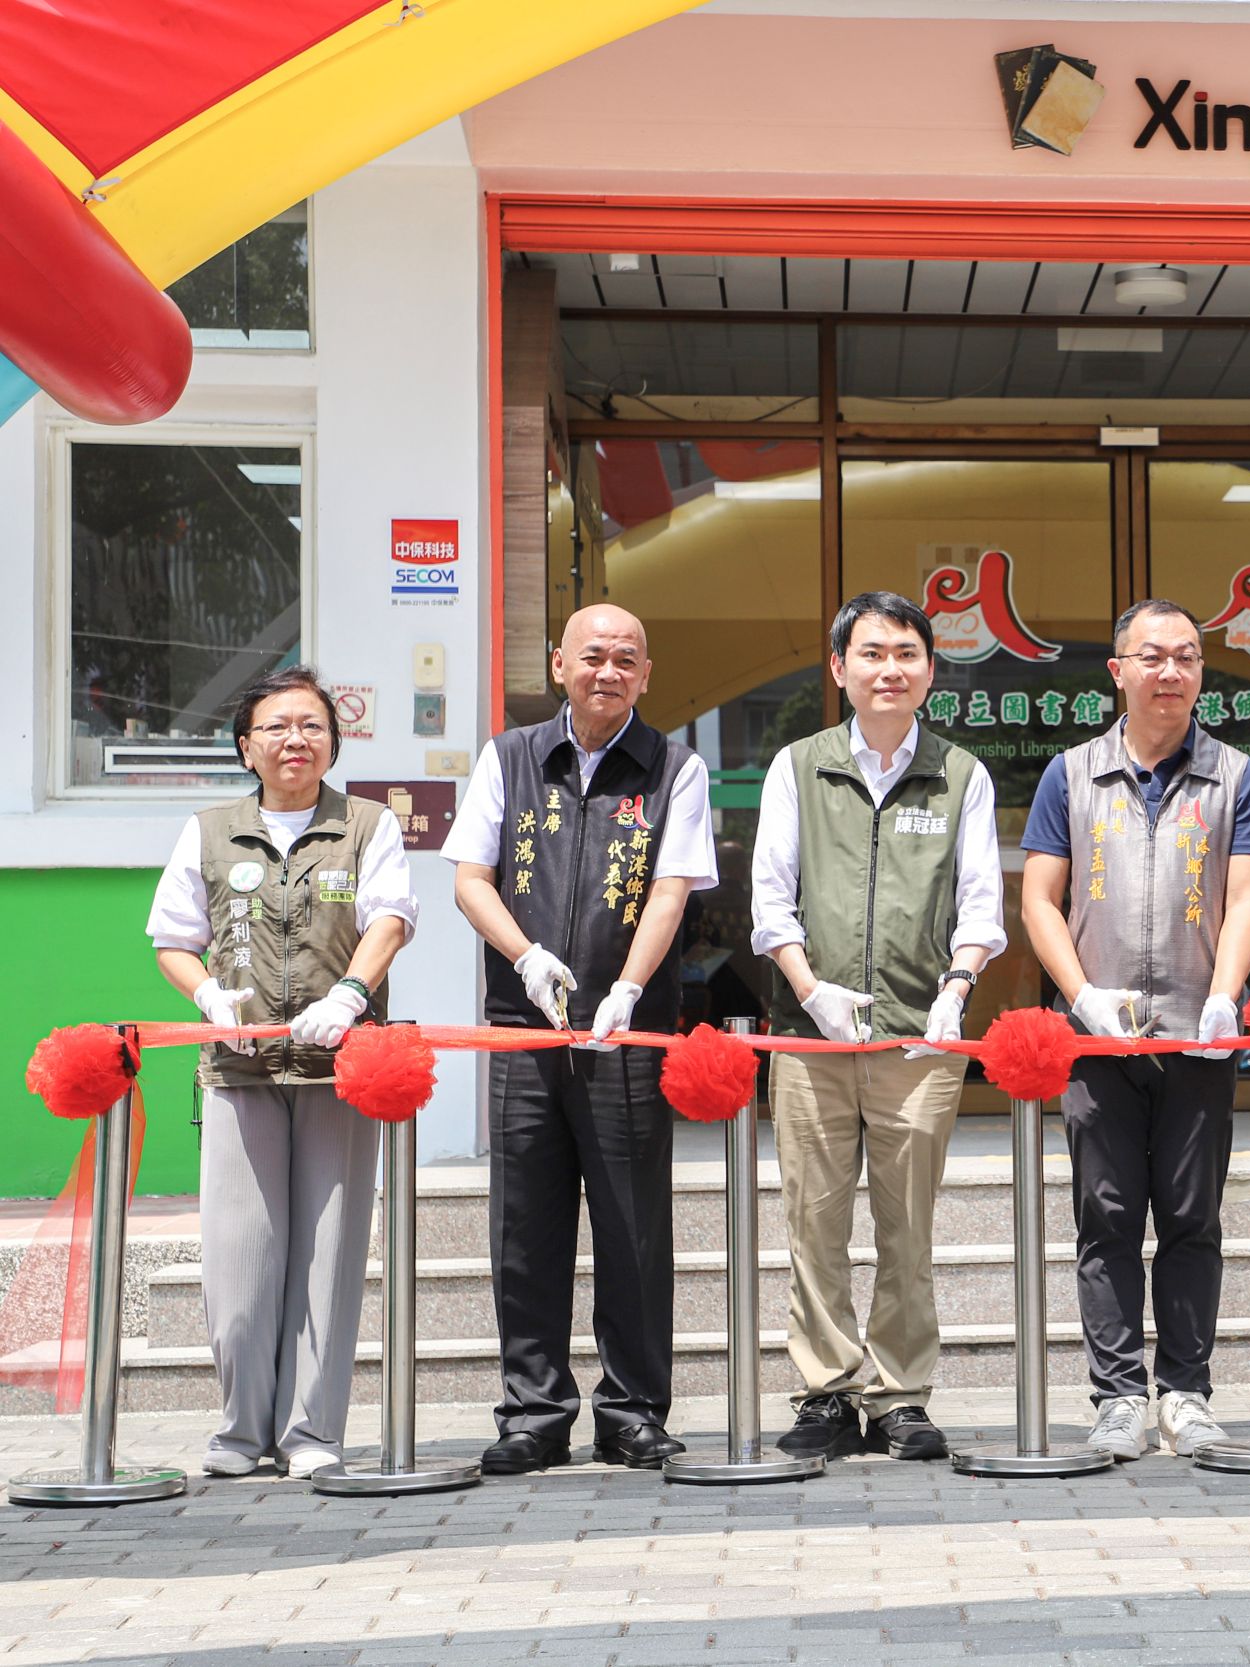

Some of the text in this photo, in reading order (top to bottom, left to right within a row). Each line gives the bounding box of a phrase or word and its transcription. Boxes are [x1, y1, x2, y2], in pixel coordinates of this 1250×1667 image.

[395, 541, 455, 559] 中保科技
[396, 568, 454, 583] SECOM
[914, 691, 1104, 727] 鄉立圖書館
[541, 789, 562, 835] 主席
[894, 816, 947, 835] 陳冠廷
[602, 839, 627, 910] 代表會
[251, 898, 263, 920] 助理
[230, 898, 252, 969] 廖利凌
